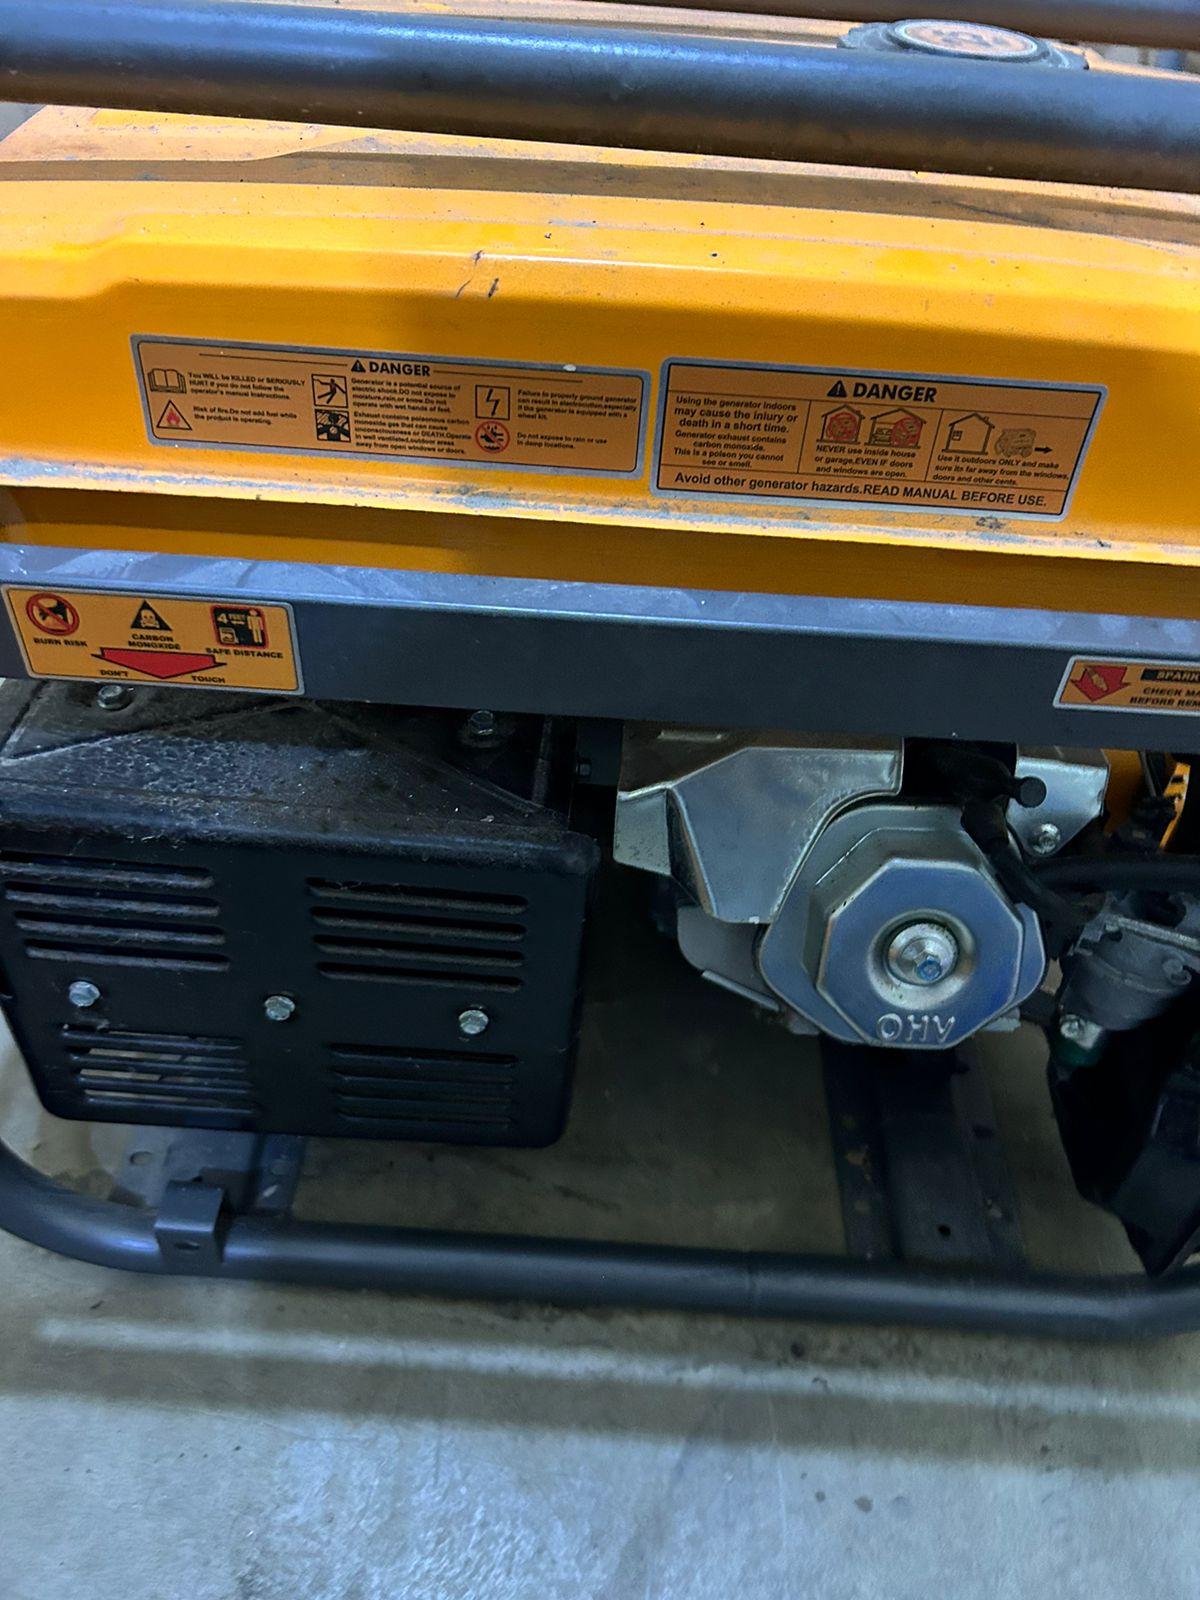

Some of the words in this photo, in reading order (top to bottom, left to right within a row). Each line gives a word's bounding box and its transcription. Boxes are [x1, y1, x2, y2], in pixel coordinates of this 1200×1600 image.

[369, 361, 430, 376] DANGER
[266, 377, 305, 386] SERIOUSLY
[351, 378, 384, 386] Generator
[550, 392, 578, 401] properly
[852, 382, 937, 402] DANGER
[676, 395, 701, 406] Using
[703, 397, 718, 406] the
[720, 400, 761, 409] generator
[763, 402, 796, 411] indoors
[674, 407, 697, 418] may
[700, 409, 731, 418] cause
[734, 410, 751, 419] the
[786, 414, 798, 423] or
[679, 418, 709, 428] death
[711, 419, 722, 429] in
[733, 421, 761, 431] short
[764, 422, 789, 433] time.
[675, 430, 716, 439] Generator
[717, 433, 750, 442] exhaust
[752, 436, 787, 444] contains
[525, 440, 543, 448] damp
[693, 441, 722, 449] carbon
[674, 447, 691, 456] This
[693, 448, 700, 456] is
[709, 450, 737, 458] poison
[739, 452, 754, 460] you
[756, 454, 784, 462] cannot
[816, 445, 846, 453] NEVER
[864, 448, 889, 456] inside
[890, 450, 916, 458] house
[890, 460, 913, 468] doors
[938, 454, 952, 462] Use
[962, 457, 996, 465] outdoors
[833, 467, 868, 476] windows
[978, 468, 998, 476] away
[932, 473, 955, 481] doors
[675, 472, 711, 485] Avoid
[714, 475, 747, 487] other
[749, 479, 809, 491] generator
[903, 487, 958, 501] MANUAL
[961, 490, 1015, 504] BEFORE
[1018, 494, 1047, 507] USE.
[217, 612, 228, 624] 4
[33, 637, 62, 645] BURN
[63, 639, 88, 647] RISK
[131, 633, 174, 642] CARBON
[128, 640, 181, 650] MONOXIDE
[206, 647, 232, 655] SAFE
[233, 649, 284, 659] DISTANCE
[100, 669, 128, 677] DON'T
[191, 675, 226, 684] TOUCH
[1156, 671, 1200, 681] SPARK
[1143, 687, 1183, 697] CHECK
[1129, 696, 1175, 706] BEFORE
[876, 1012, 956, 1042] OHV
